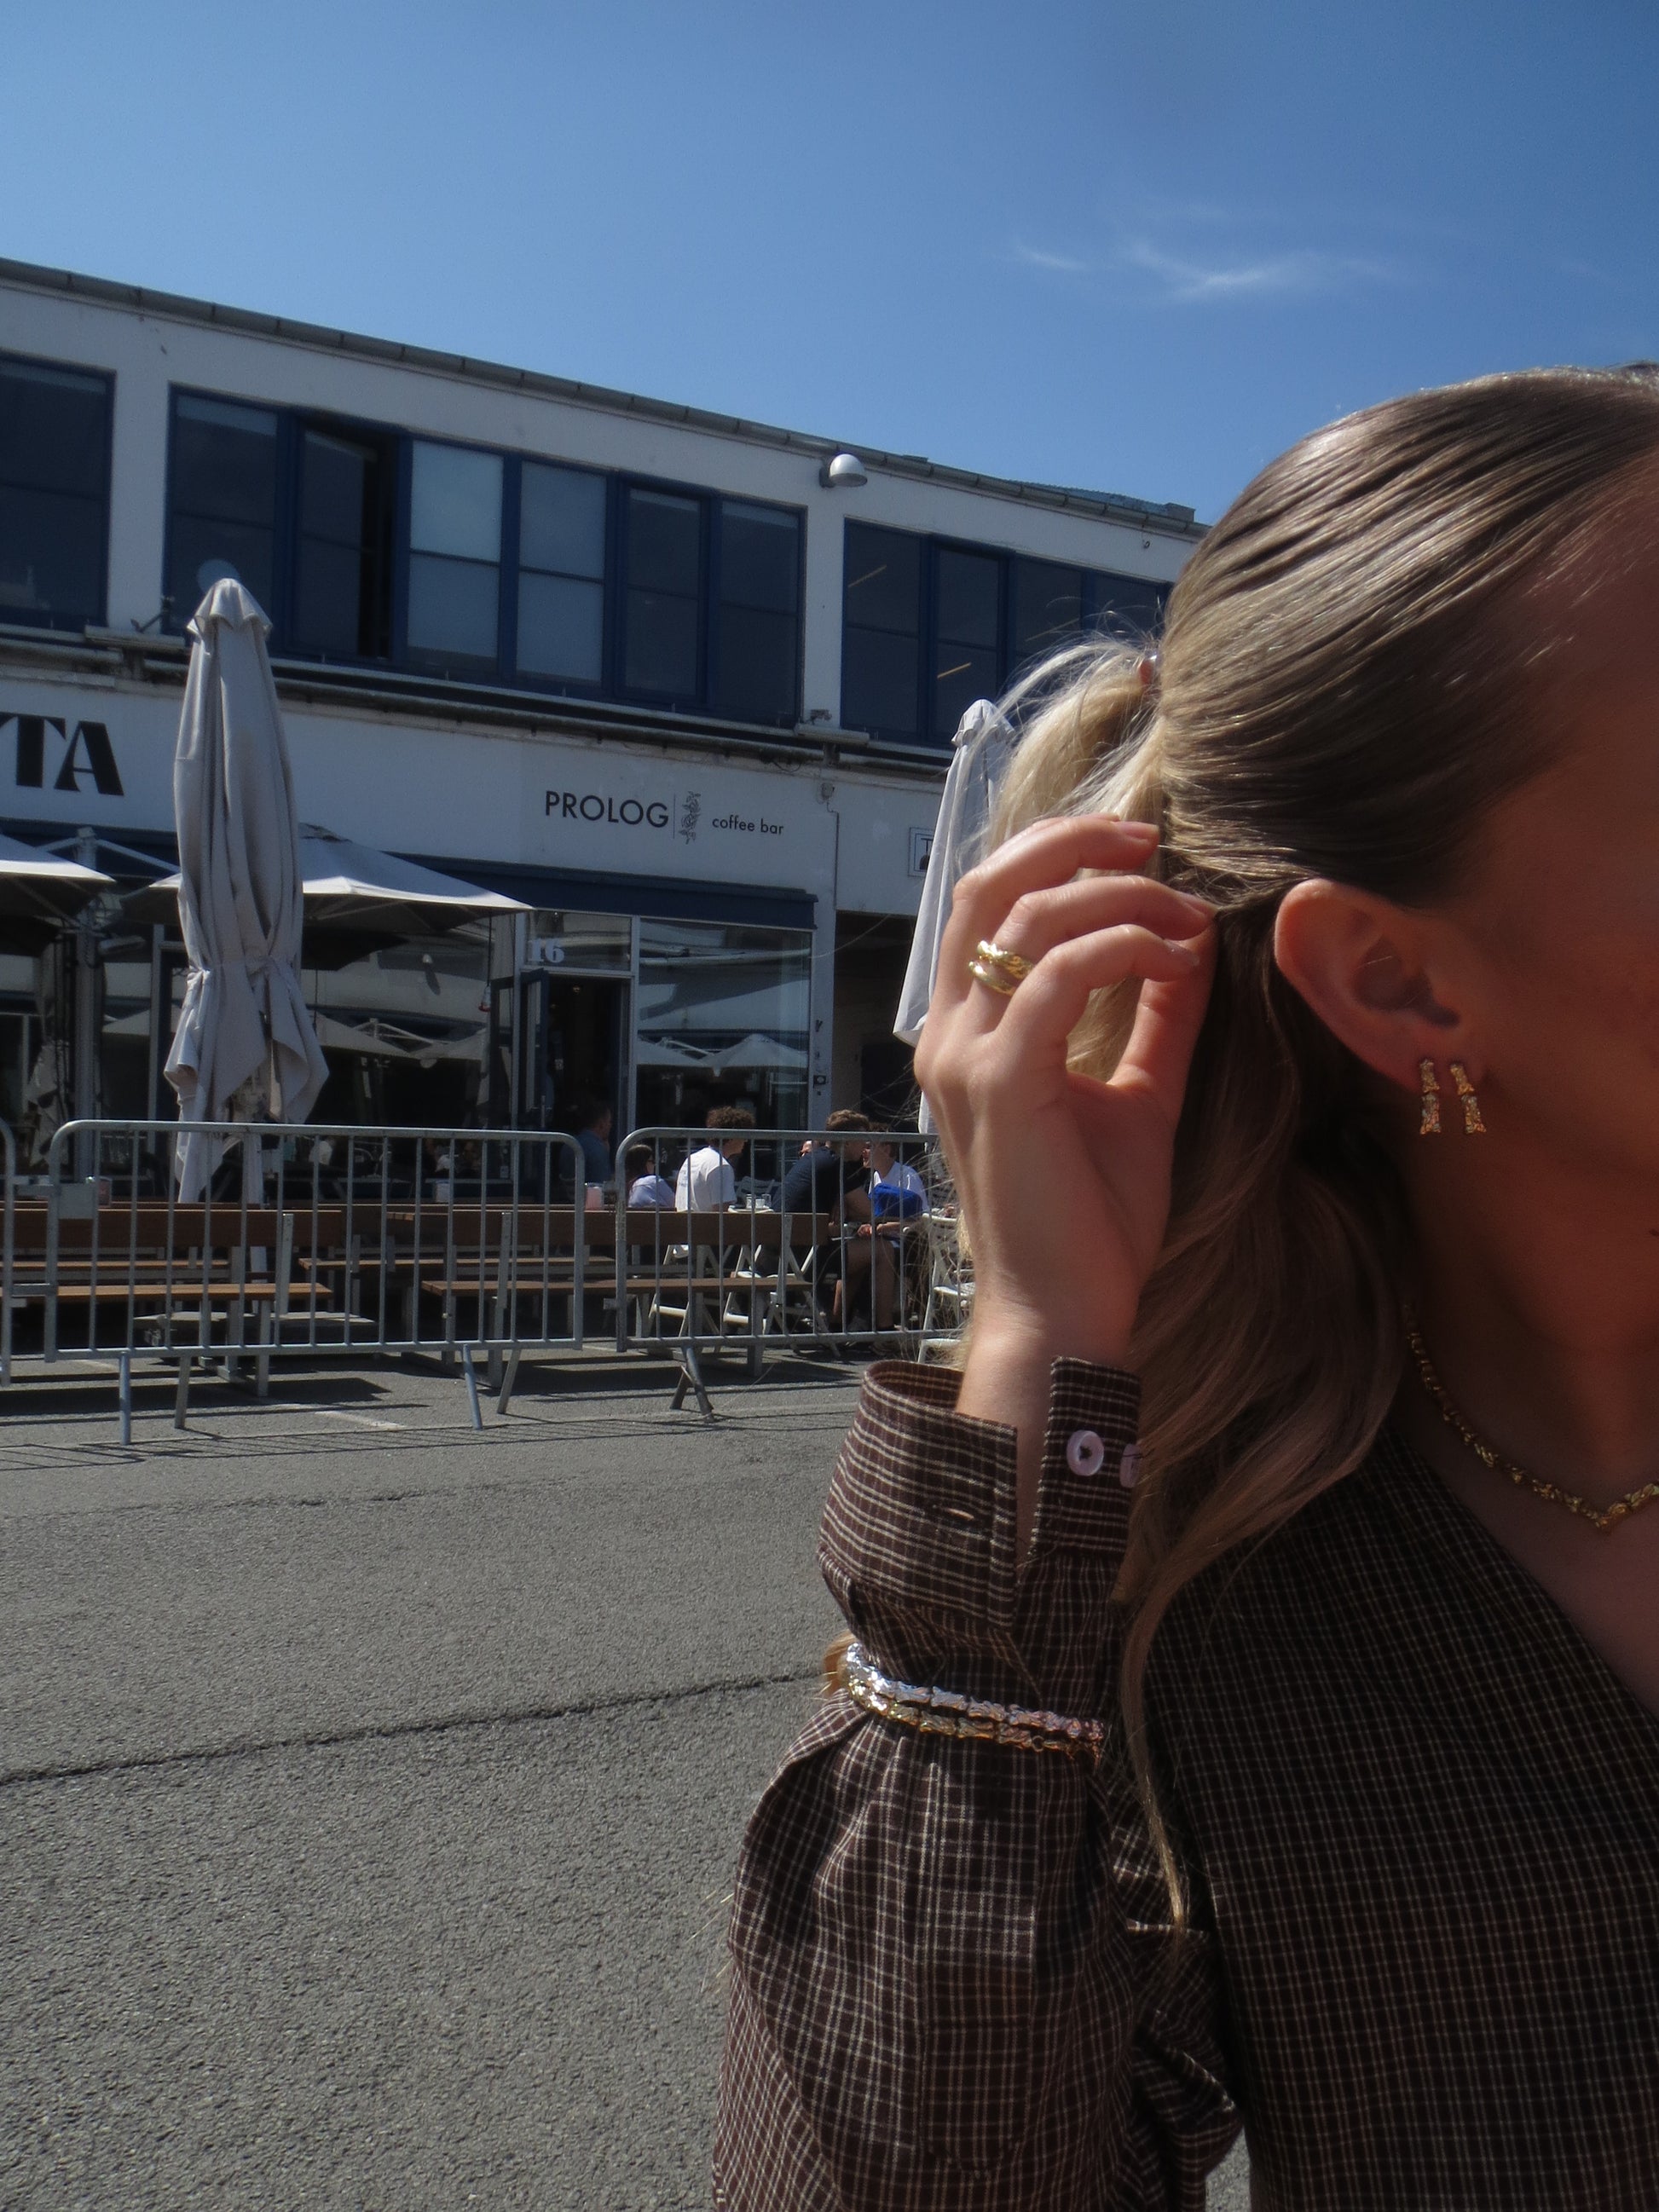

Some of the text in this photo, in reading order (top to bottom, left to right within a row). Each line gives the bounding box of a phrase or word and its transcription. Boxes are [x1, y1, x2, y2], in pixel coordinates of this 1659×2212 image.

[545, 790, 784, 835] PROLOG coffee bar
[528, 938, 565, 963] 16
